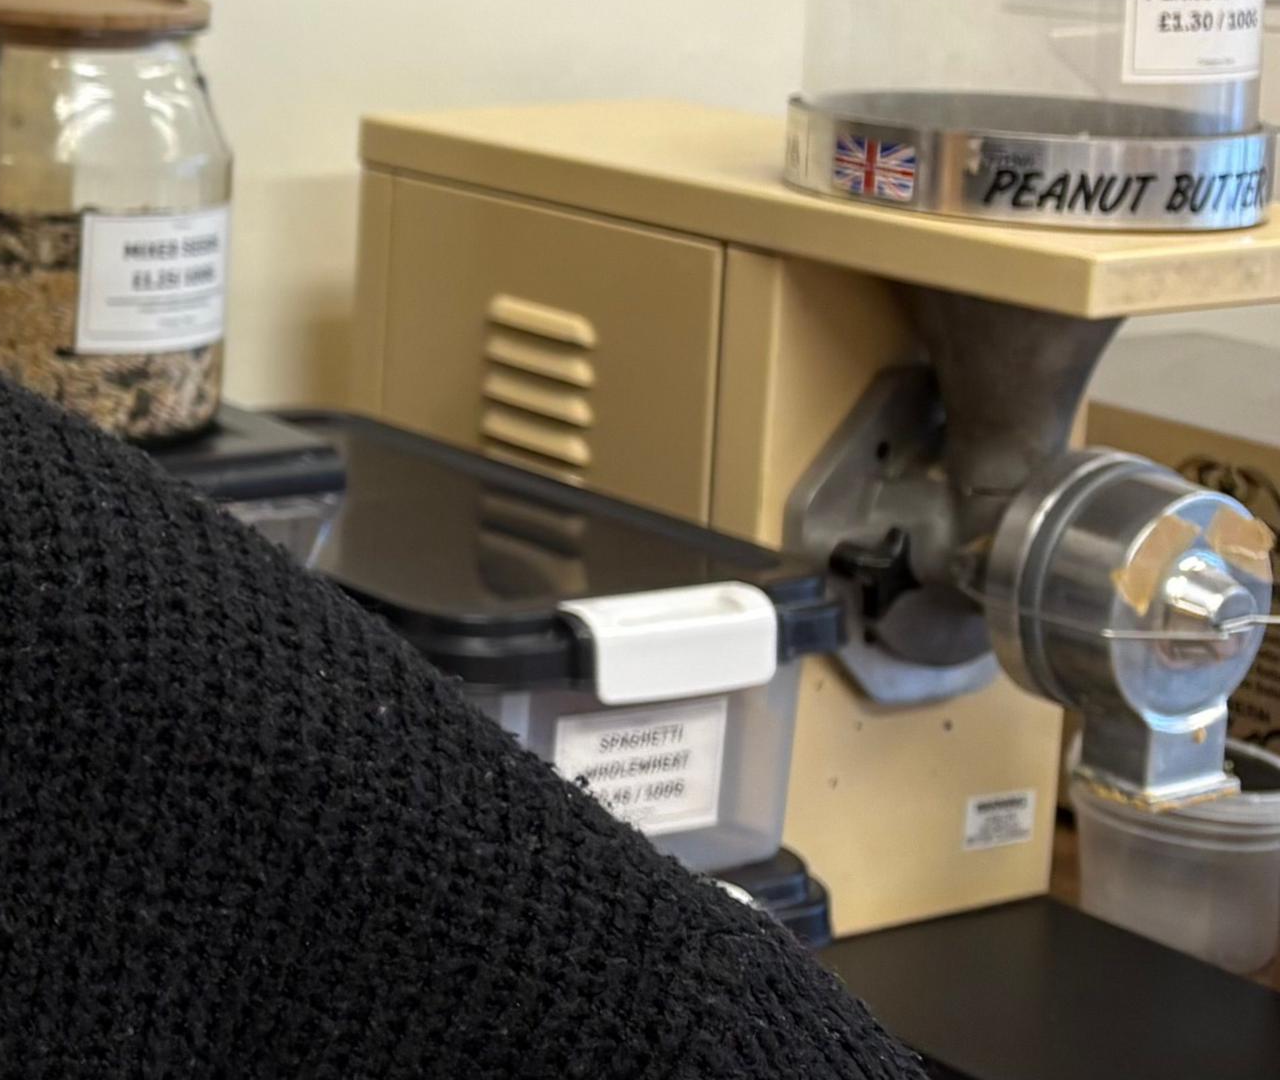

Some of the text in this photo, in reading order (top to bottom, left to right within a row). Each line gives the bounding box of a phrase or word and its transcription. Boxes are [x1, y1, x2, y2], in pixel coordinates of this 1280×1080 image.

[1158, 10, 1214, 33] £1.30
[983, 169, 1159, 213] PEANUT
[598, 724, 684, 754] SPAGHETTI
[585, 749, 691, 781] WHOLEWHEAT
